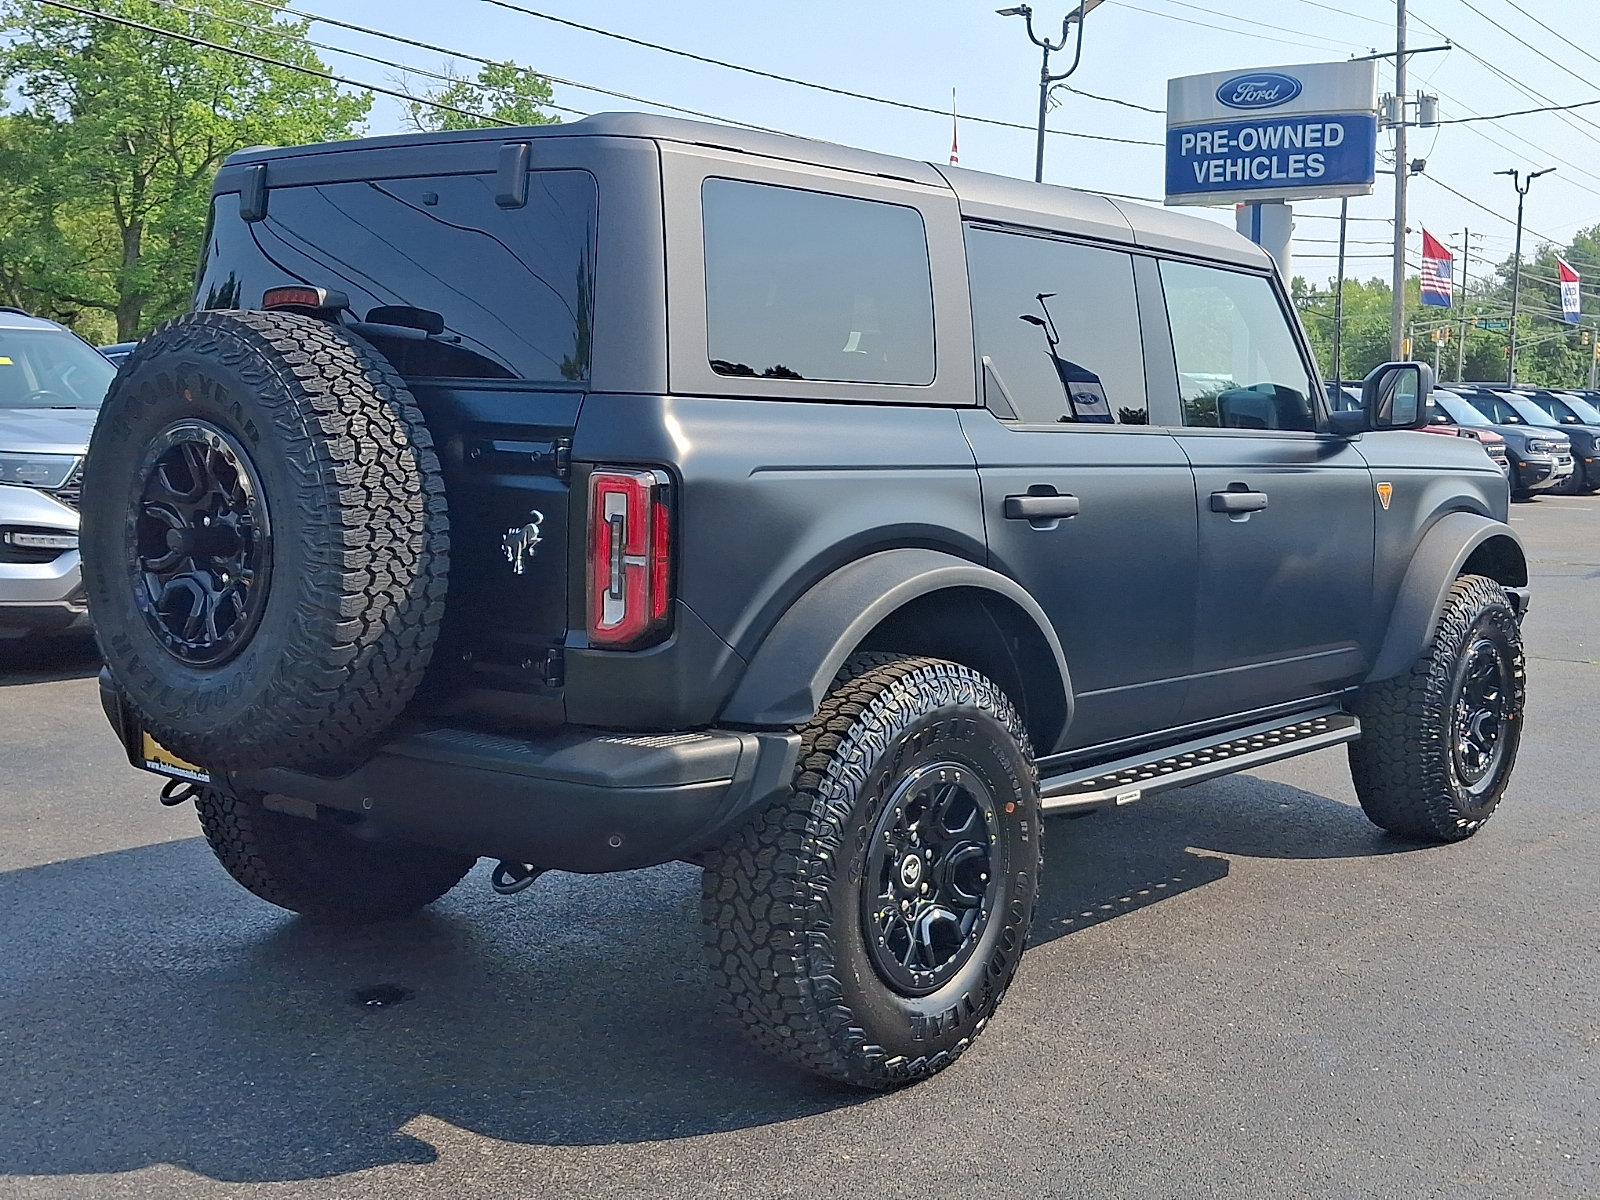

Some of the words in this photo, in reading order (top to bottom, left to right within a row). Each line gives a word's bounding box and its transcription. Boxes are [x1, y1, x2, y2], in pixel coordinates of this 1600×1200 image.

[1232, 81, 1280, 103] Ford
[1180, 122, 1345, 157] PRE-OWNED
[1192, 153, 1326, 184] VEHICLES
[847, 717, 978, 887] GOODYEAR
[909, 870, 1030, 1042] GOODYEAR
